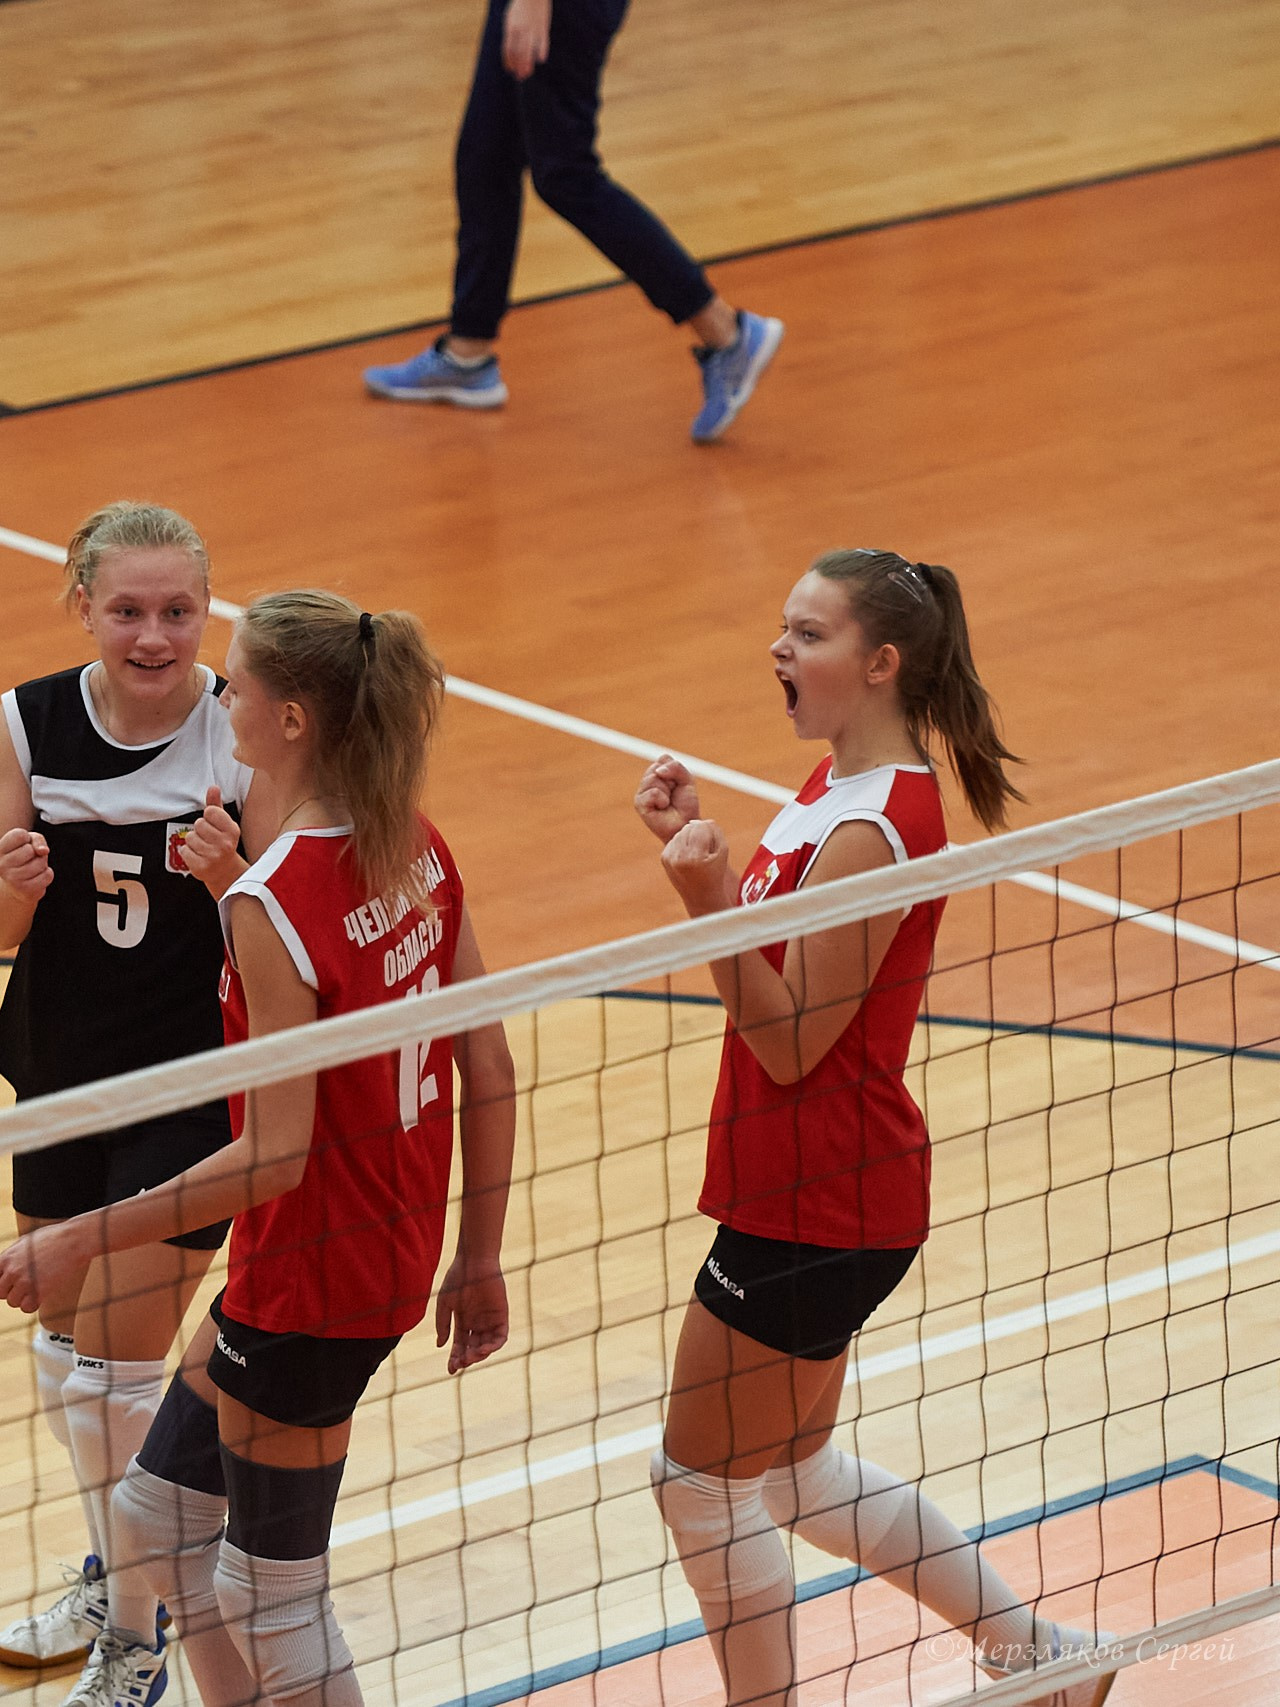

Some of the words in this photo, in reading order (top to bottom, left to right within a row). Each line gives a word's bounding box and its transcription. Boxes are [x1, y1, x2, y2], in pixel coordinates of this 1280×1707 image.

[92, 849, 150, 949] 5
[384, 910, 443, 987] ОБЛАСТЬ
[399, 964, 440, 1133] 12
